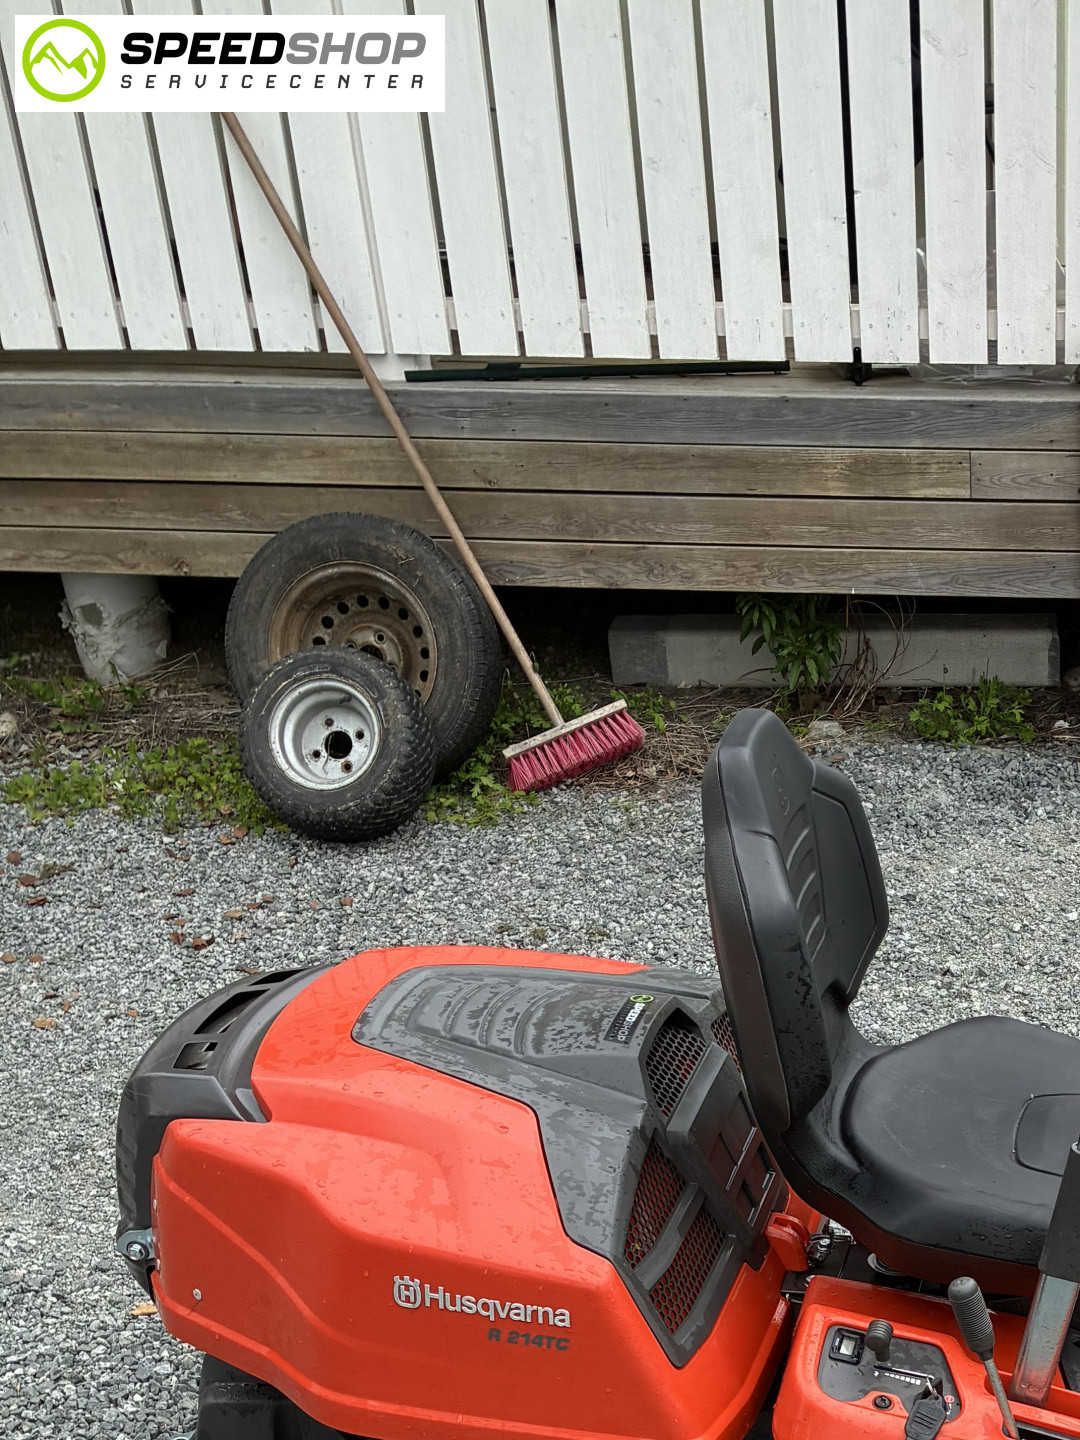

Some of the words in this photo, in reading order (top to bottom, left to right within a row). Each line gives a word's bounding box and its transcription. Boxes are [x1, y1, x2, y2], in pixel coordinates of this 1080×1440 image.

[424, 1283, 571, 1328] Husqvarna
[488, 1328, 501, 1341] R
[507, 1330, 569, 1351] 214TC
